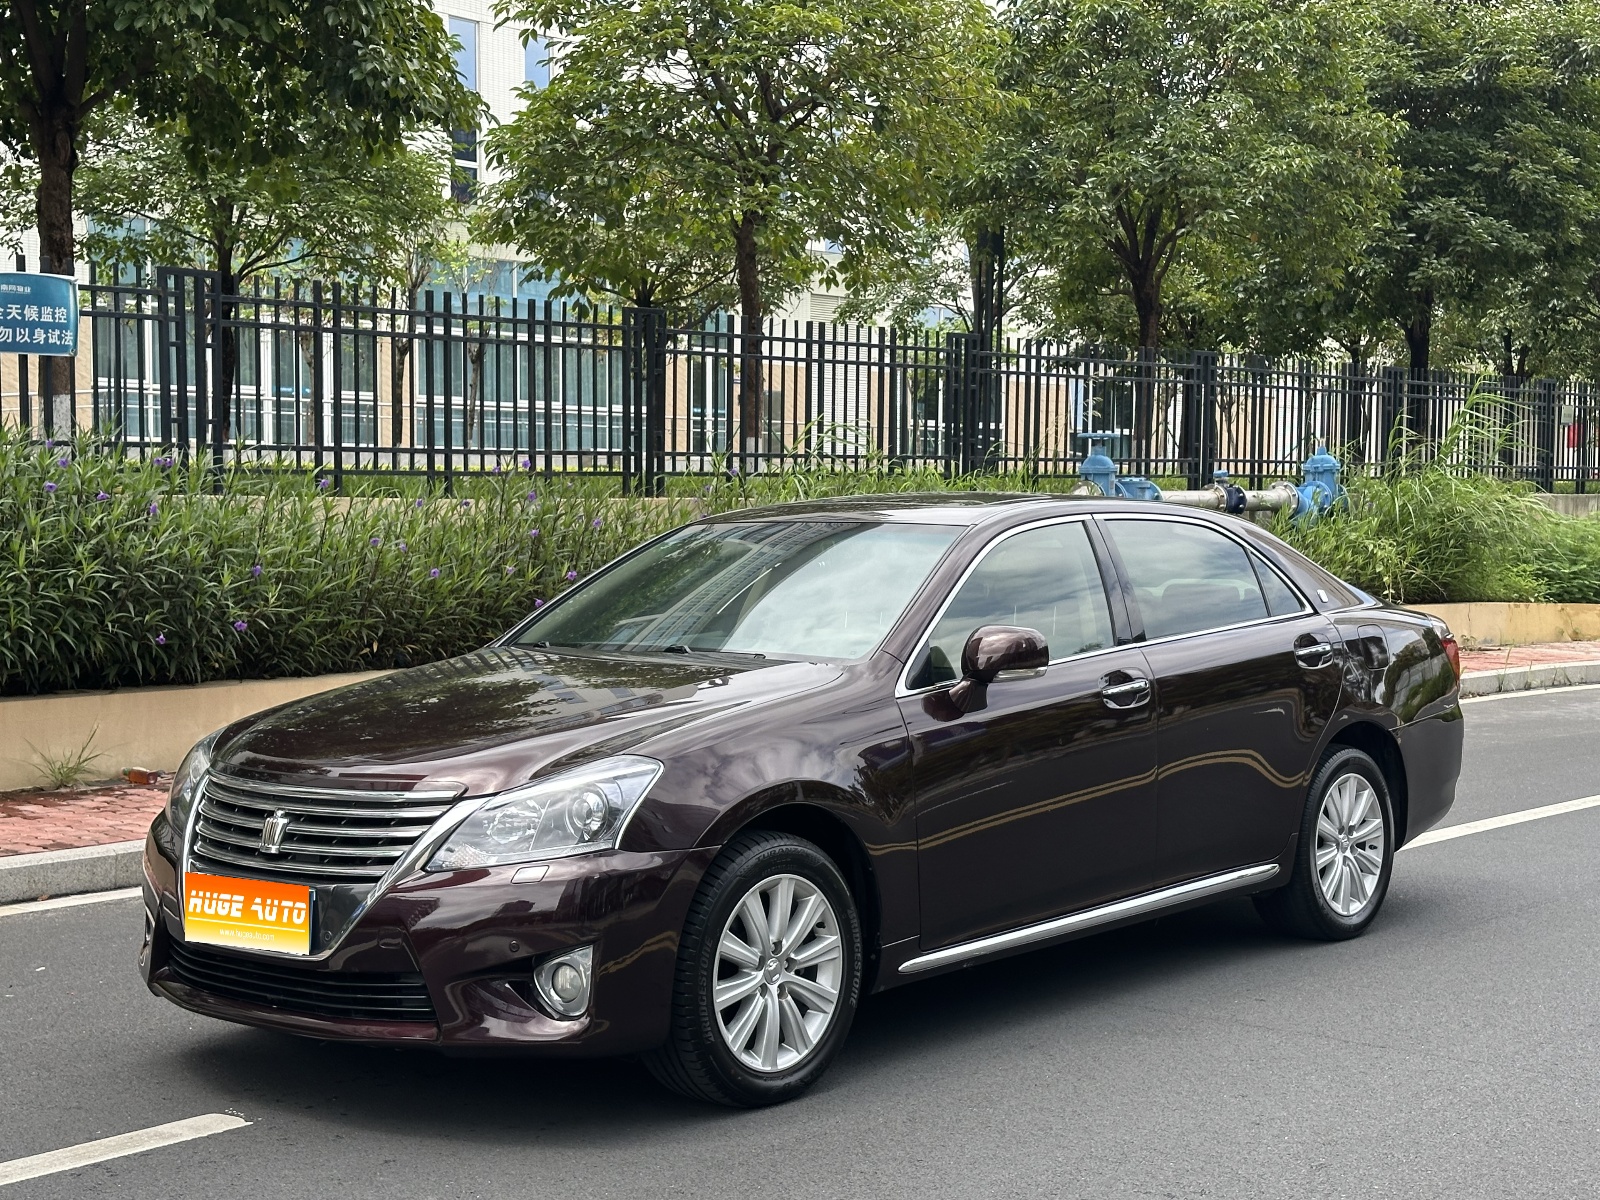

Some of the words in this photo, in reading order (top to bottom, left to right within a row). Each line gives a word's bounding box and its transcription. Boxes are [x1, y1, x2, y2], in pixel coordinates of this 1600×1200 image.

[0, 326, 74, 346] 勿以身试法
